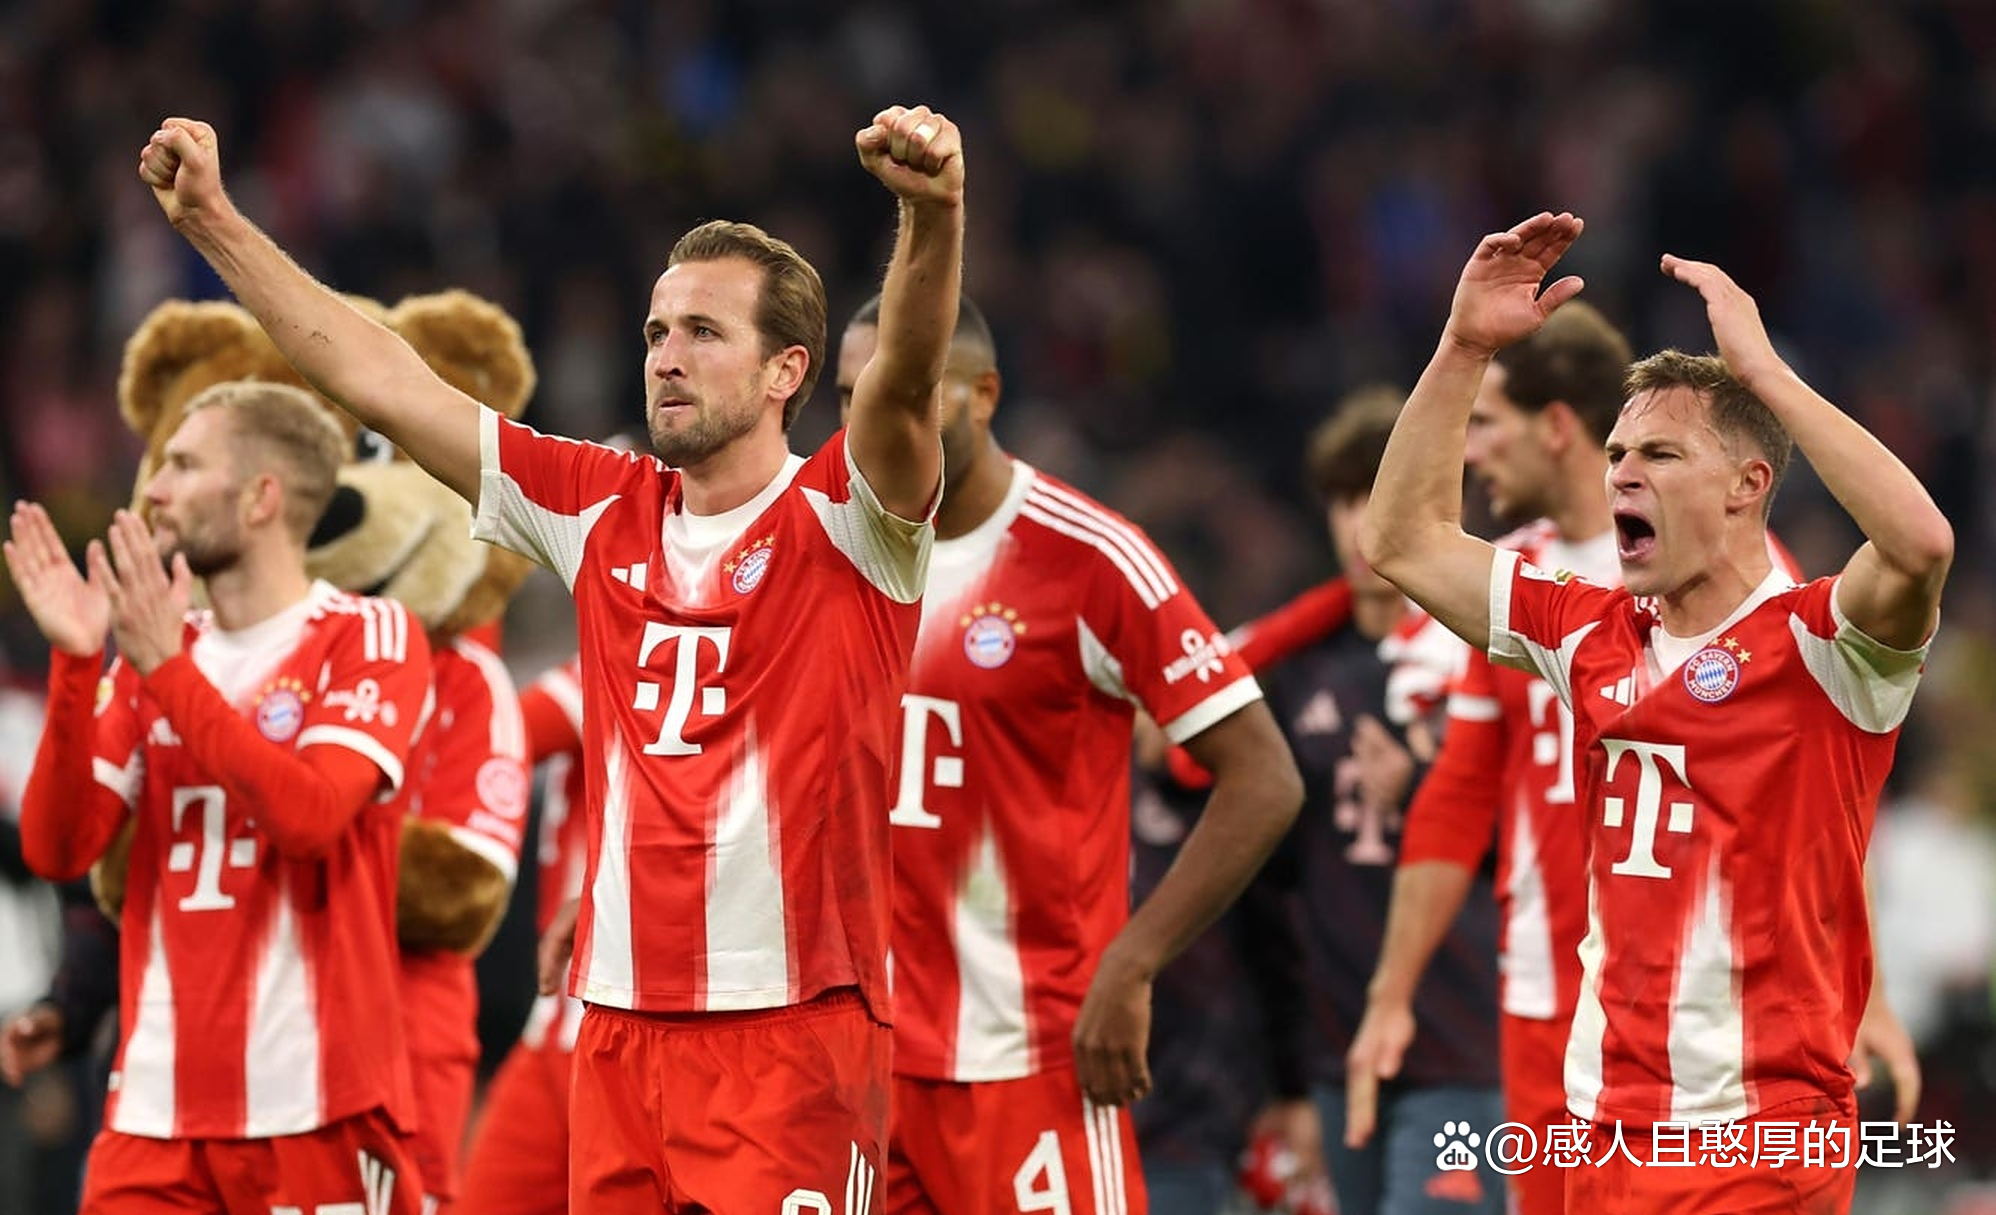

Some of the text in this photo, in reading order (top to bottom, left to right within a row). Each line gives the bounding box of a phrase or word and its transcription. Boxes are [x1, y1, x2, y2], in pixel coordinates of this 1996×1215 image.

[633, 622, 732, 756] T
[168, 786, 257, 912] T
[1601, 739, 1695, 879] T
[1013, 1129, 1072, 1215] 4
